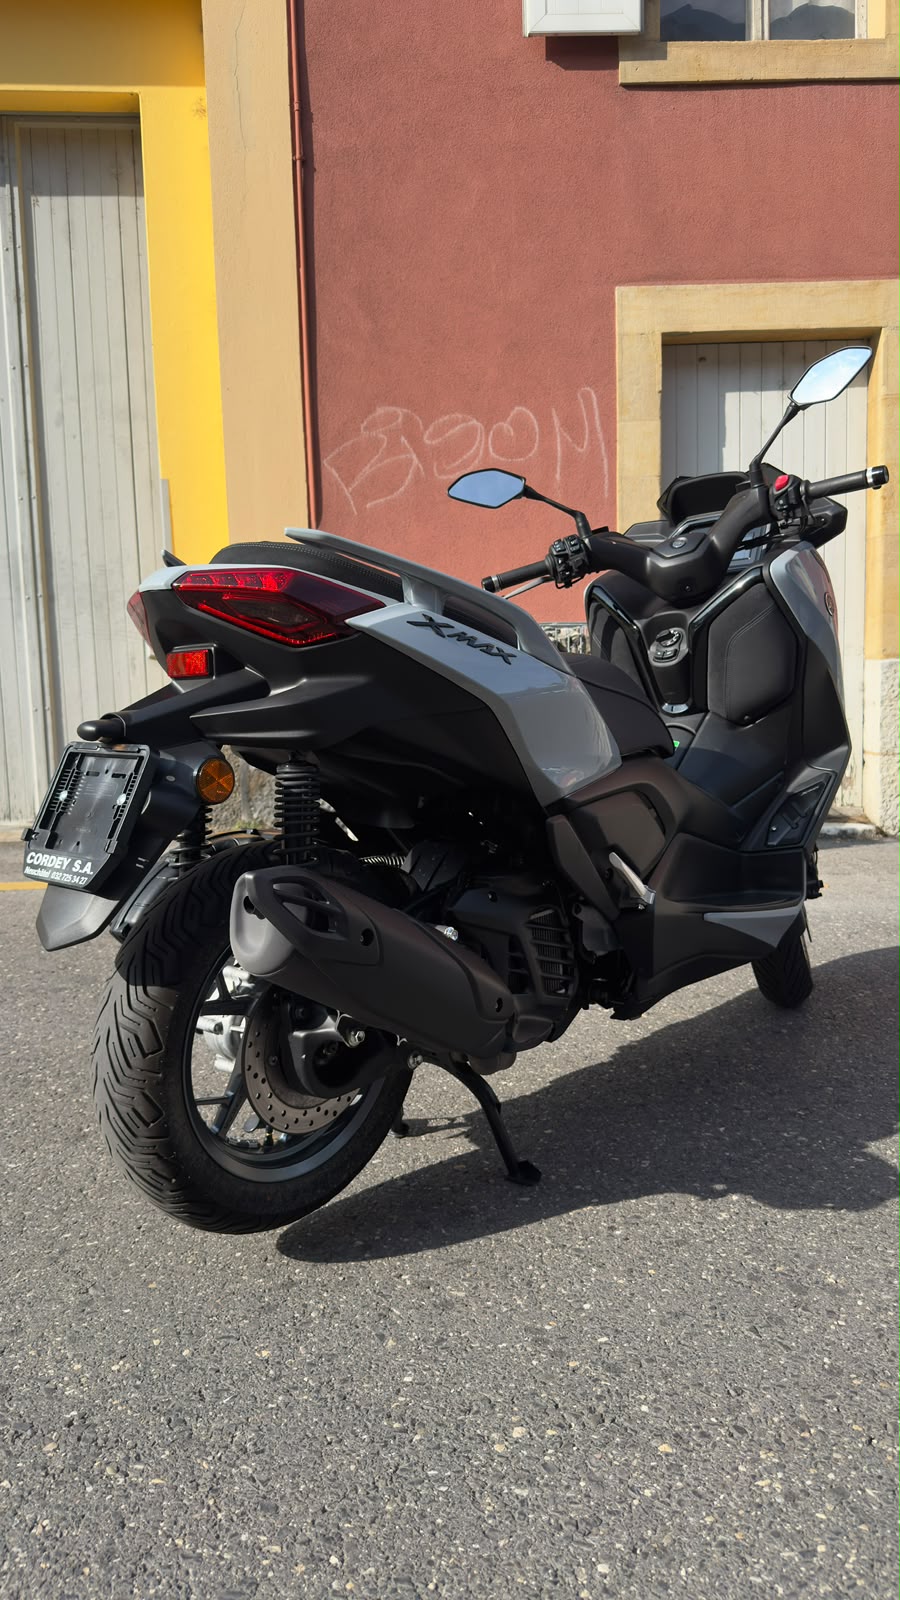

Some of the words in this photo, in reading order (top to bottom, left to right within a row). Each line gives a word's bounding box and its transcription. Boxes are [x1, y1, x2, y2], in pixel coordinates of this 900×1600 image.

[406, 613, 517, 665] XMAX
[26, 852, 72, 870] CORDEY
[72, 860, 94, 875] S.A.
[51, 871, 63, 881] 032
[62, 873, 72, 883] 725
[71, 875, 80, 884] 34
[79, 877, 89, 885] 27
